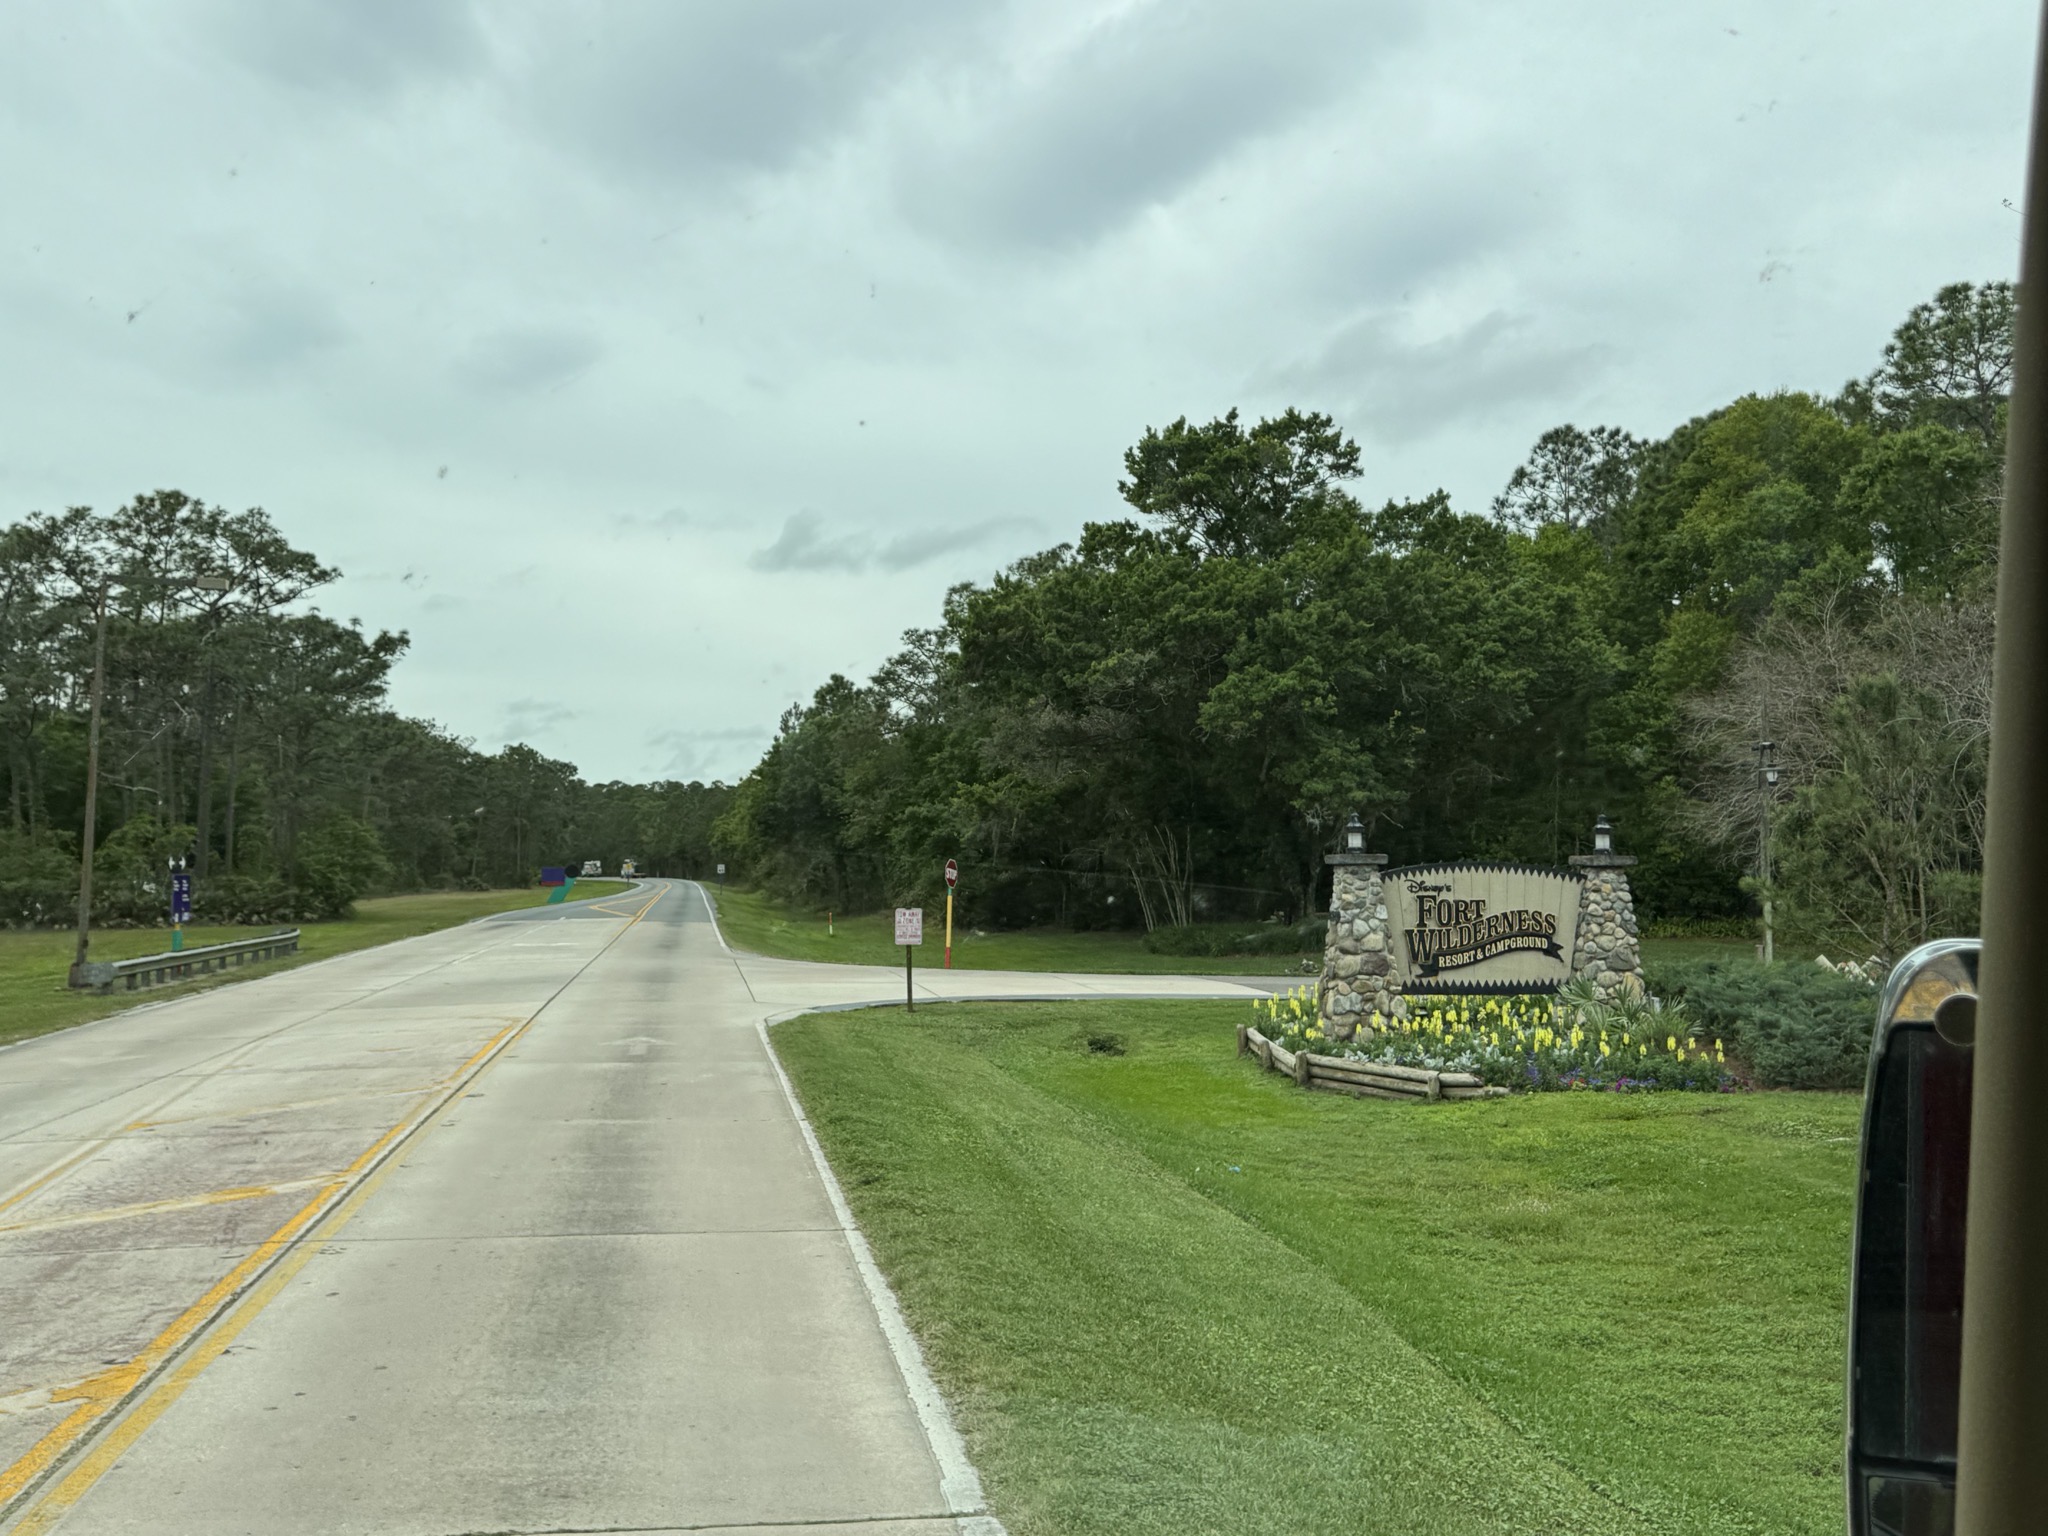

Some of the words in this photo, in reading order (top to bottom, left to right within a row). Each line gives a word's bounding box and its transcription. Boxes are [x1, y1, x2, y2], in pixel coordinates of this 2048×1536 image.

[1415, 894, 1486, 928] FORT
[1405, 909, 1557, 963] WILDERNESS
[1438, 950, 1476, 968] RESORT
[1476, 948, 1485, 960] &
[1485, 936, 1549, 957] CAMPGROUND
